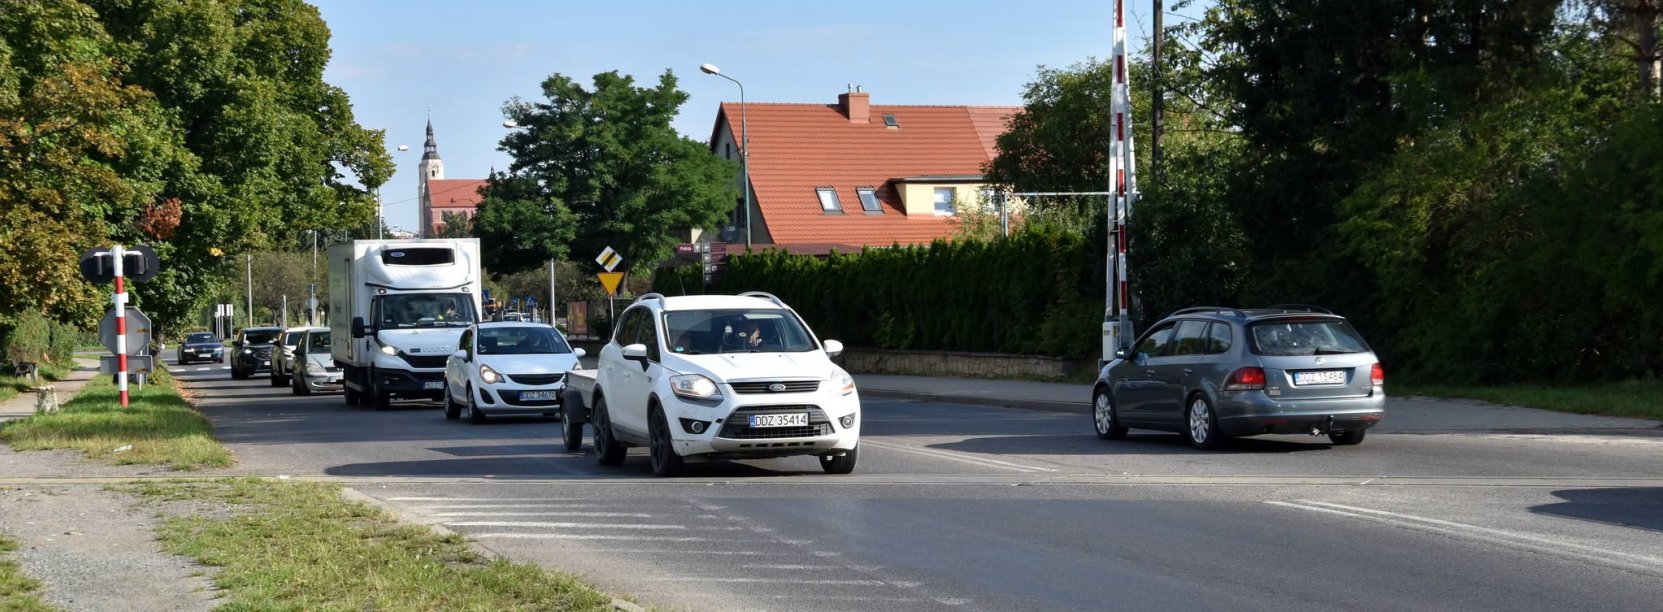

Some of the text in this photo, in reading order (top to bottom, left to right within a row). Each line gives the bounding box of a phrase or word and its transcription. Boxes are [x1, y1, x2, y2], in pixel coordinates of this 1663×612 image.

[1300, 372, 1316, 381] DDZ
[755, 414, 807, 426] DDZ 35414
